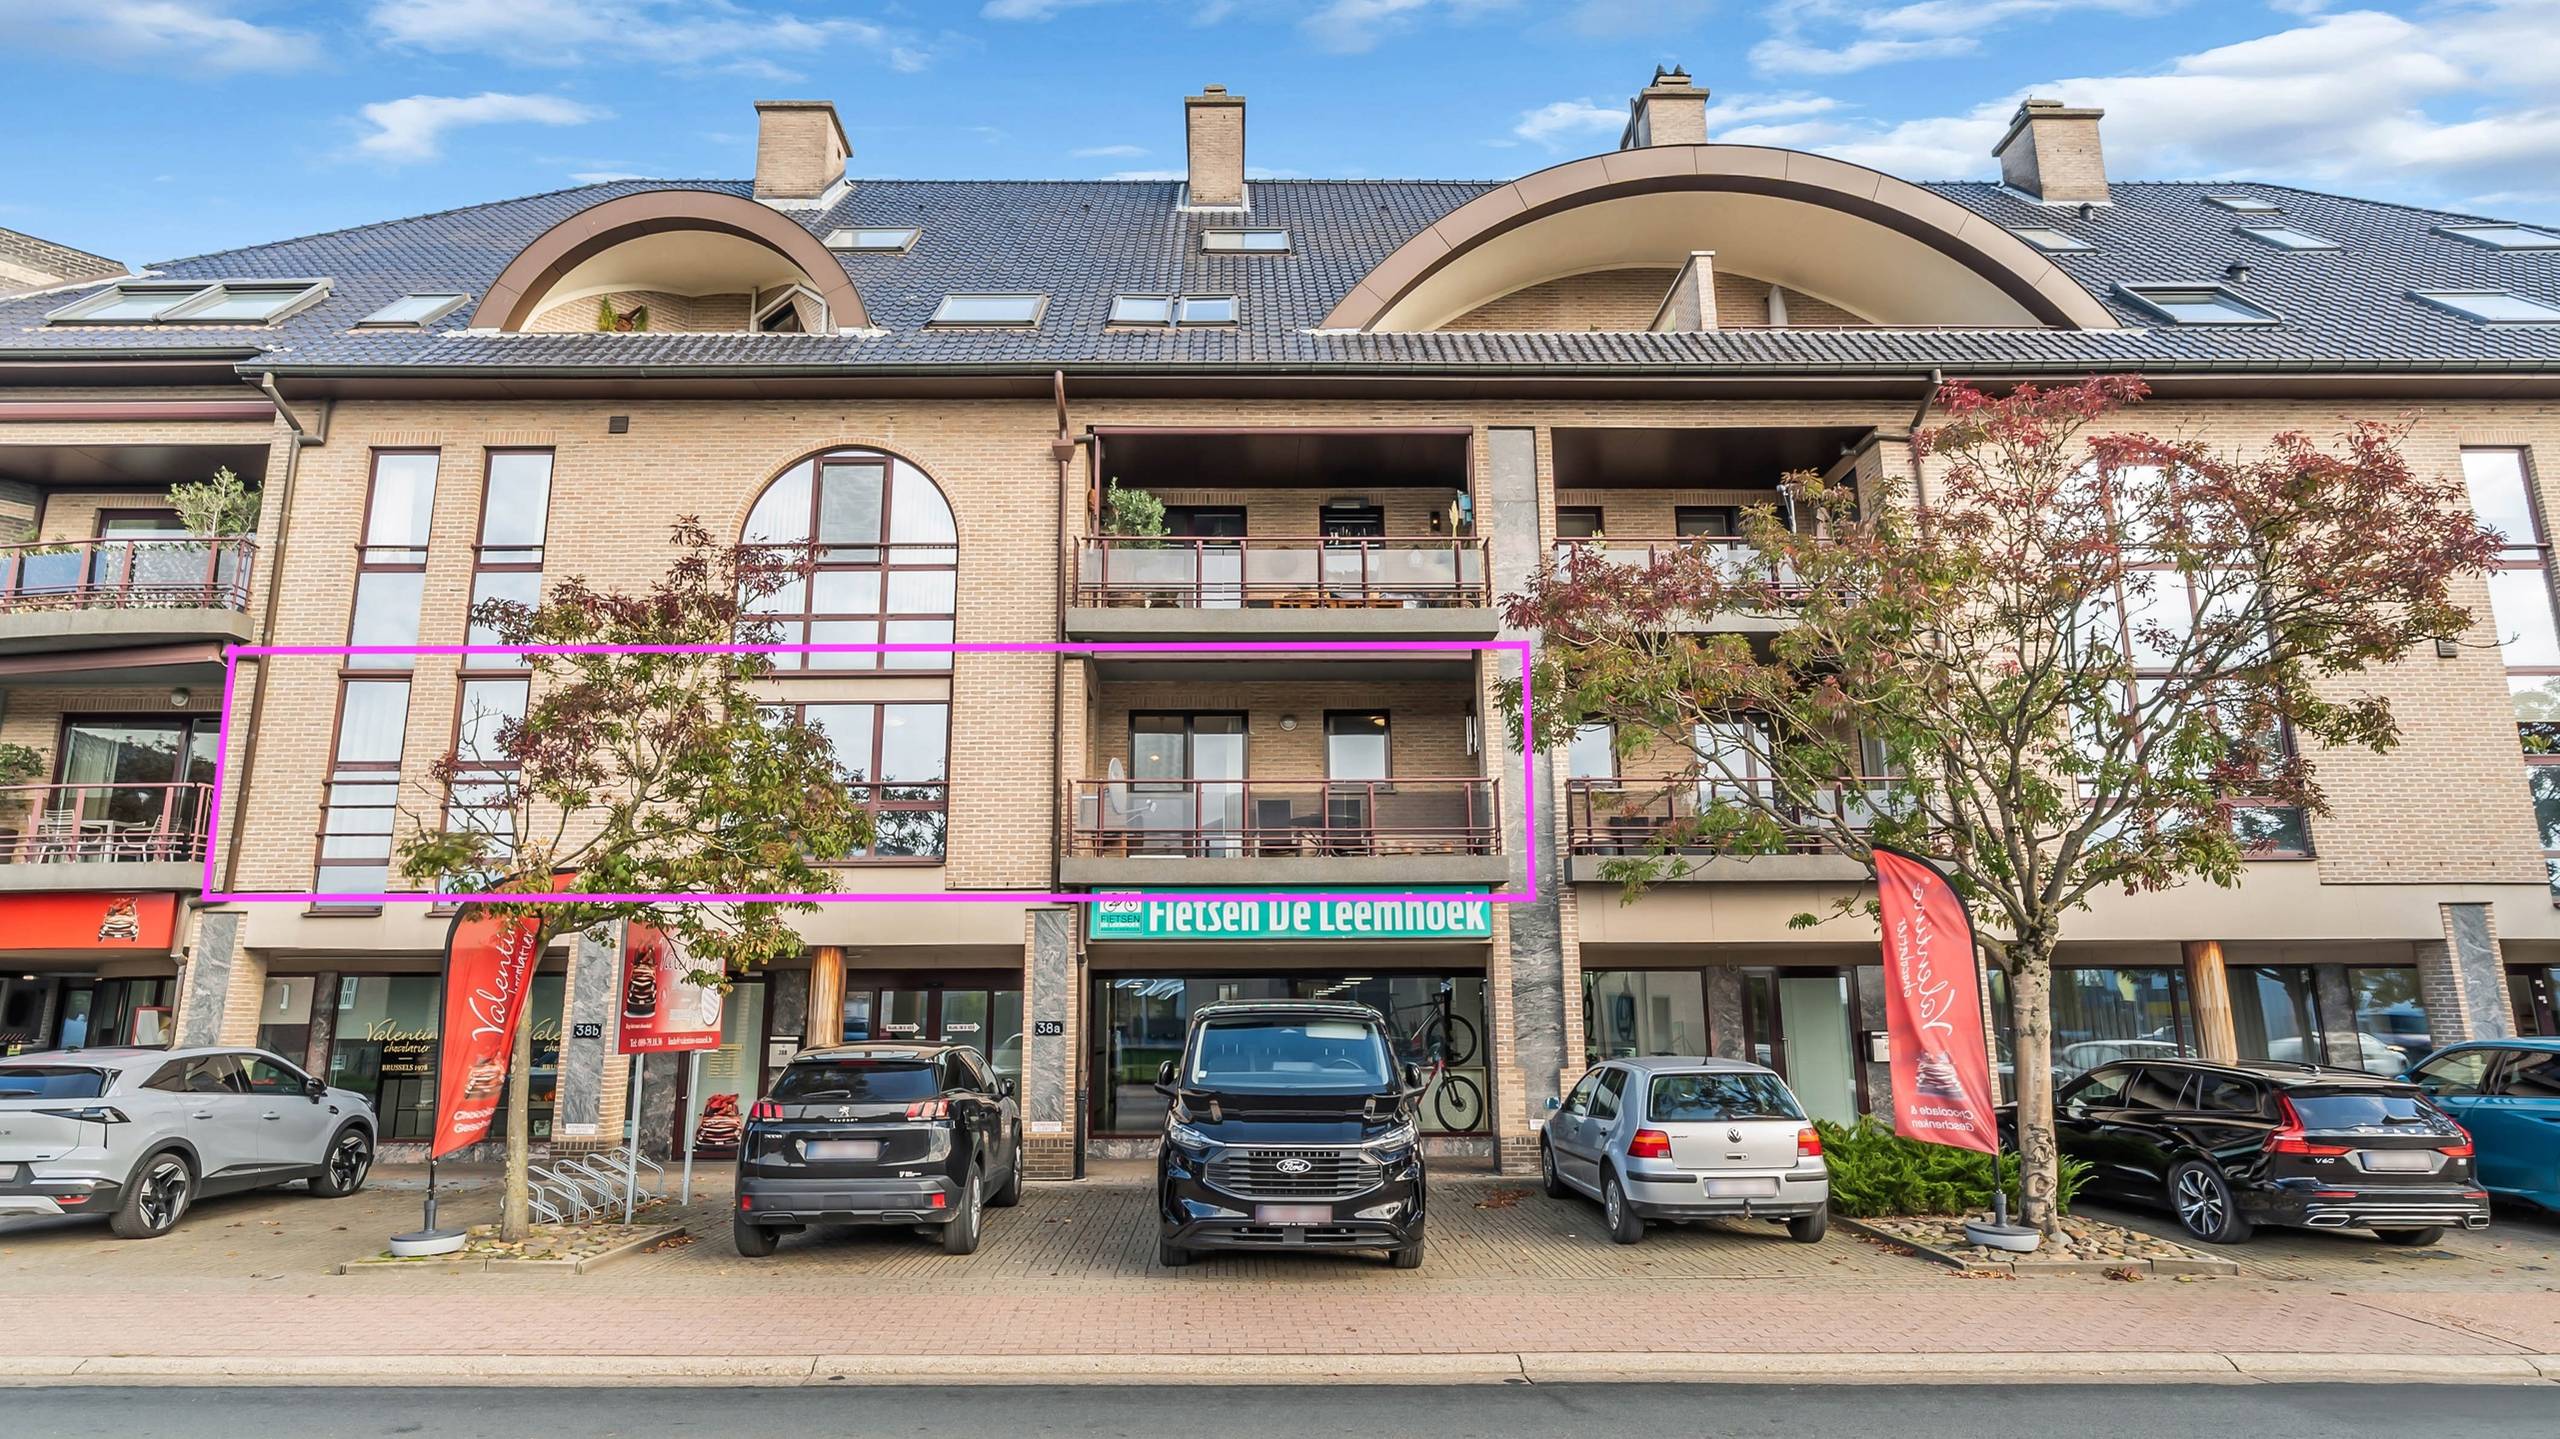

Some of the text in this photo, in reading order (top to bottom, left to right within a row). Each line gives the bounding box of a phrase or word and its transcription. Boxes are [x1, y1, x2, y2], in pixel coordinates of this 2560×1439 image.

[1149, 891, 1486, 932] Fietsen De Leemhoek
[1101, 914, 1140, 923] FIETSEN
[575, 1025, 599, 1036] 38b
[1037, 1022, 1060, 1034] 38a
[1282, 1161, 1305, 1171] Ford
